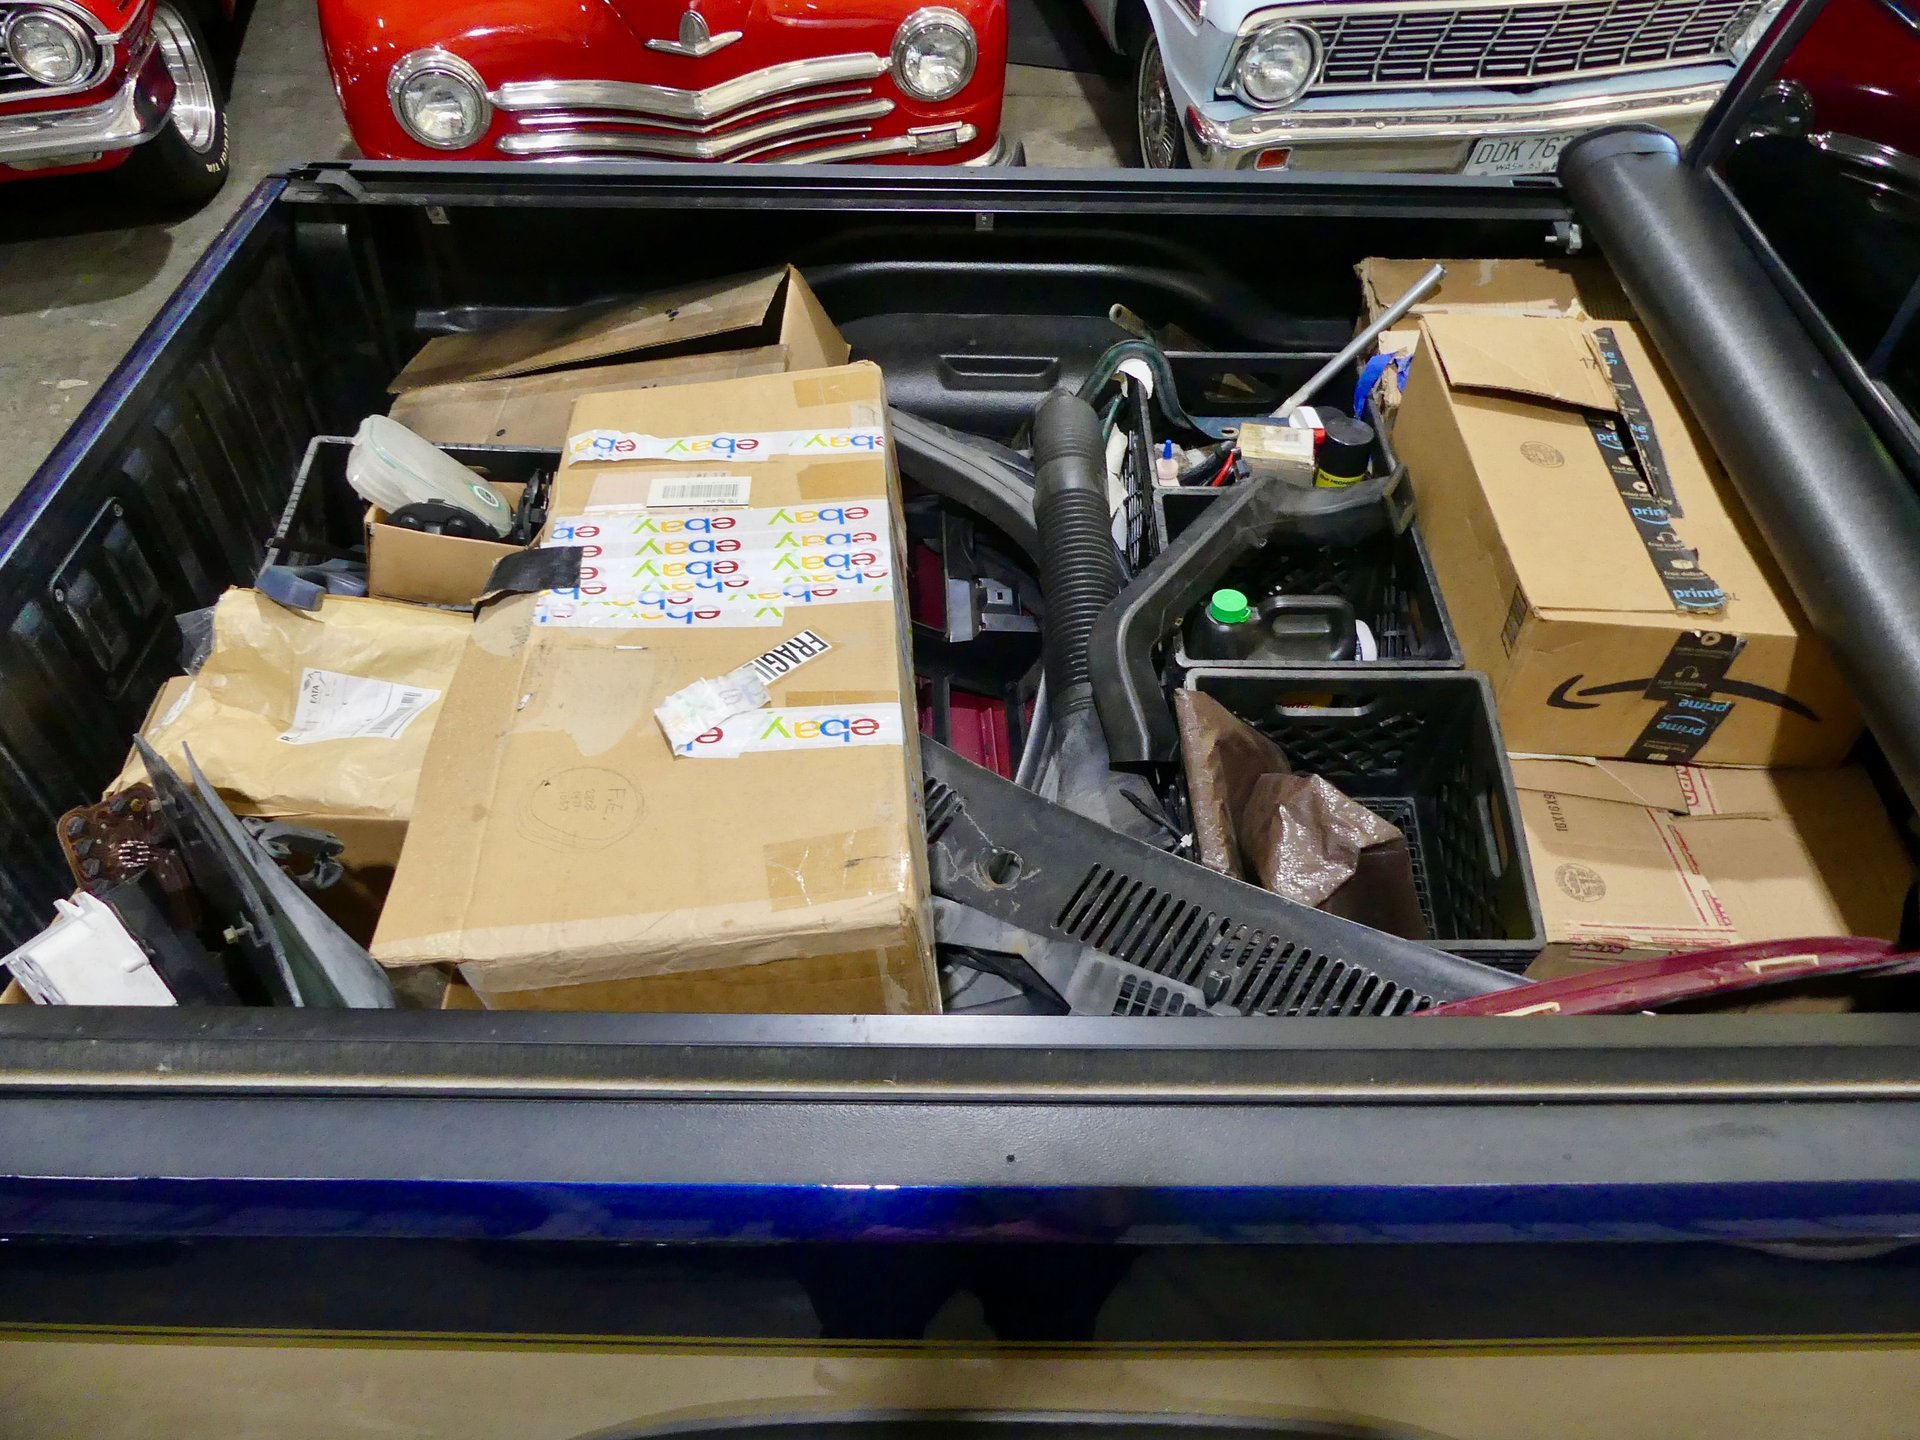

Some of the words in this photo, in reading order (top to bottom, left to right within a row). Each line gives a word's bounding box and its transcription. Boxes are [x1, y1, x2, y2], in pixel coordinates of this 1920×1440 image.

[1474, 140, 1526, 164] DDK
[574, 438, 637, 455] eba
[665, 437, 759, 458] ebay
[768, 506, 870, 525] ebay
[551, 525, 600, 540] eb
[633, 516, 737, 535] ebay
[636, 538, 741, 555] ebay
[775, 531, 877, 548] ebay
[632, 559, 739, 579] ebay
[773, 552, 876, 572] ebay
[1673, 588, 1724, 600] prime
[742, 630, 829, 681] FRAGIL
[1678, 698, 1729, 712] prime
[761, 718, 880, 743] ebay
[1656, 721, 1706, 737] prime
[1543, 791, 1568, 832] 16X16X9
